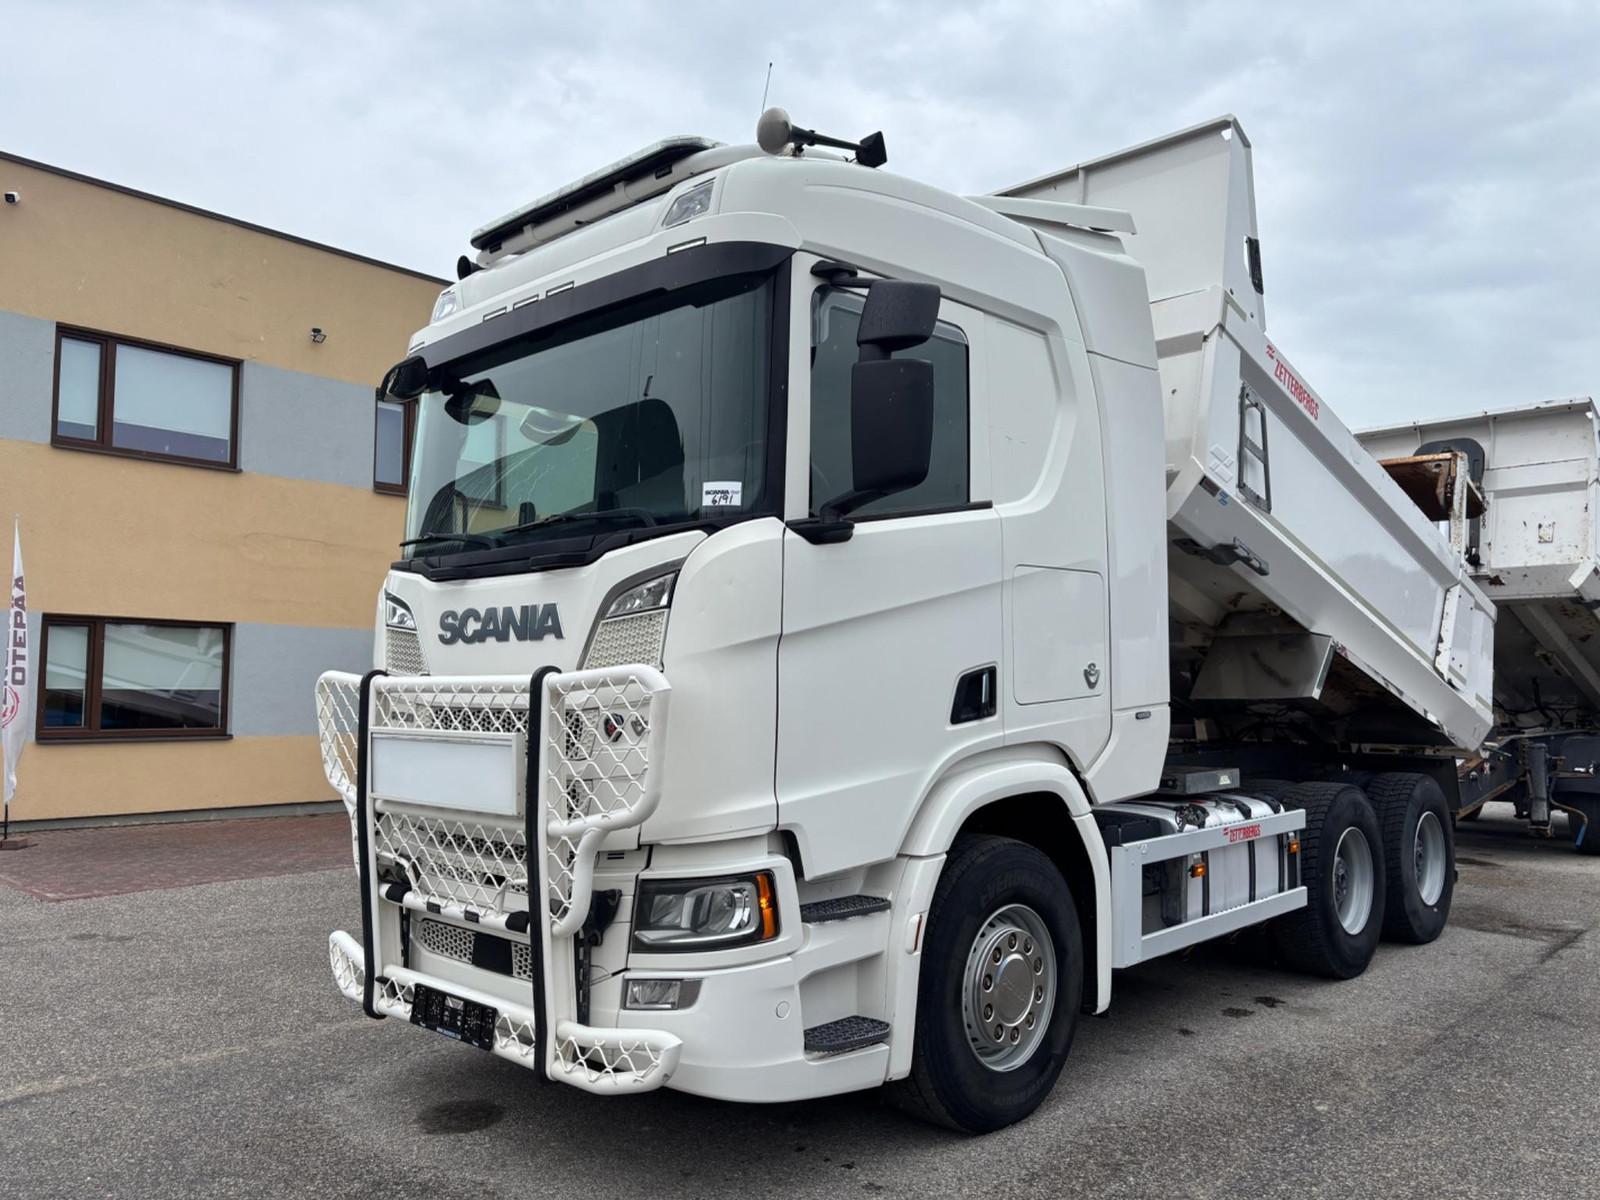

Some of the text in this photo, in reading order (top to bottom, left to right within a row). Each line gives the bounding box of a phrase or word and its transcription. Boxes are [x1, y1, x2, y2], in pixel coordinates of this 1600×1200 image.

[1274, 359, 1320, 420] ZETTERBERGS
[11, 575, 26, 686] OTEPÄÄ
[438, 602, 565, 646] SCANIA
